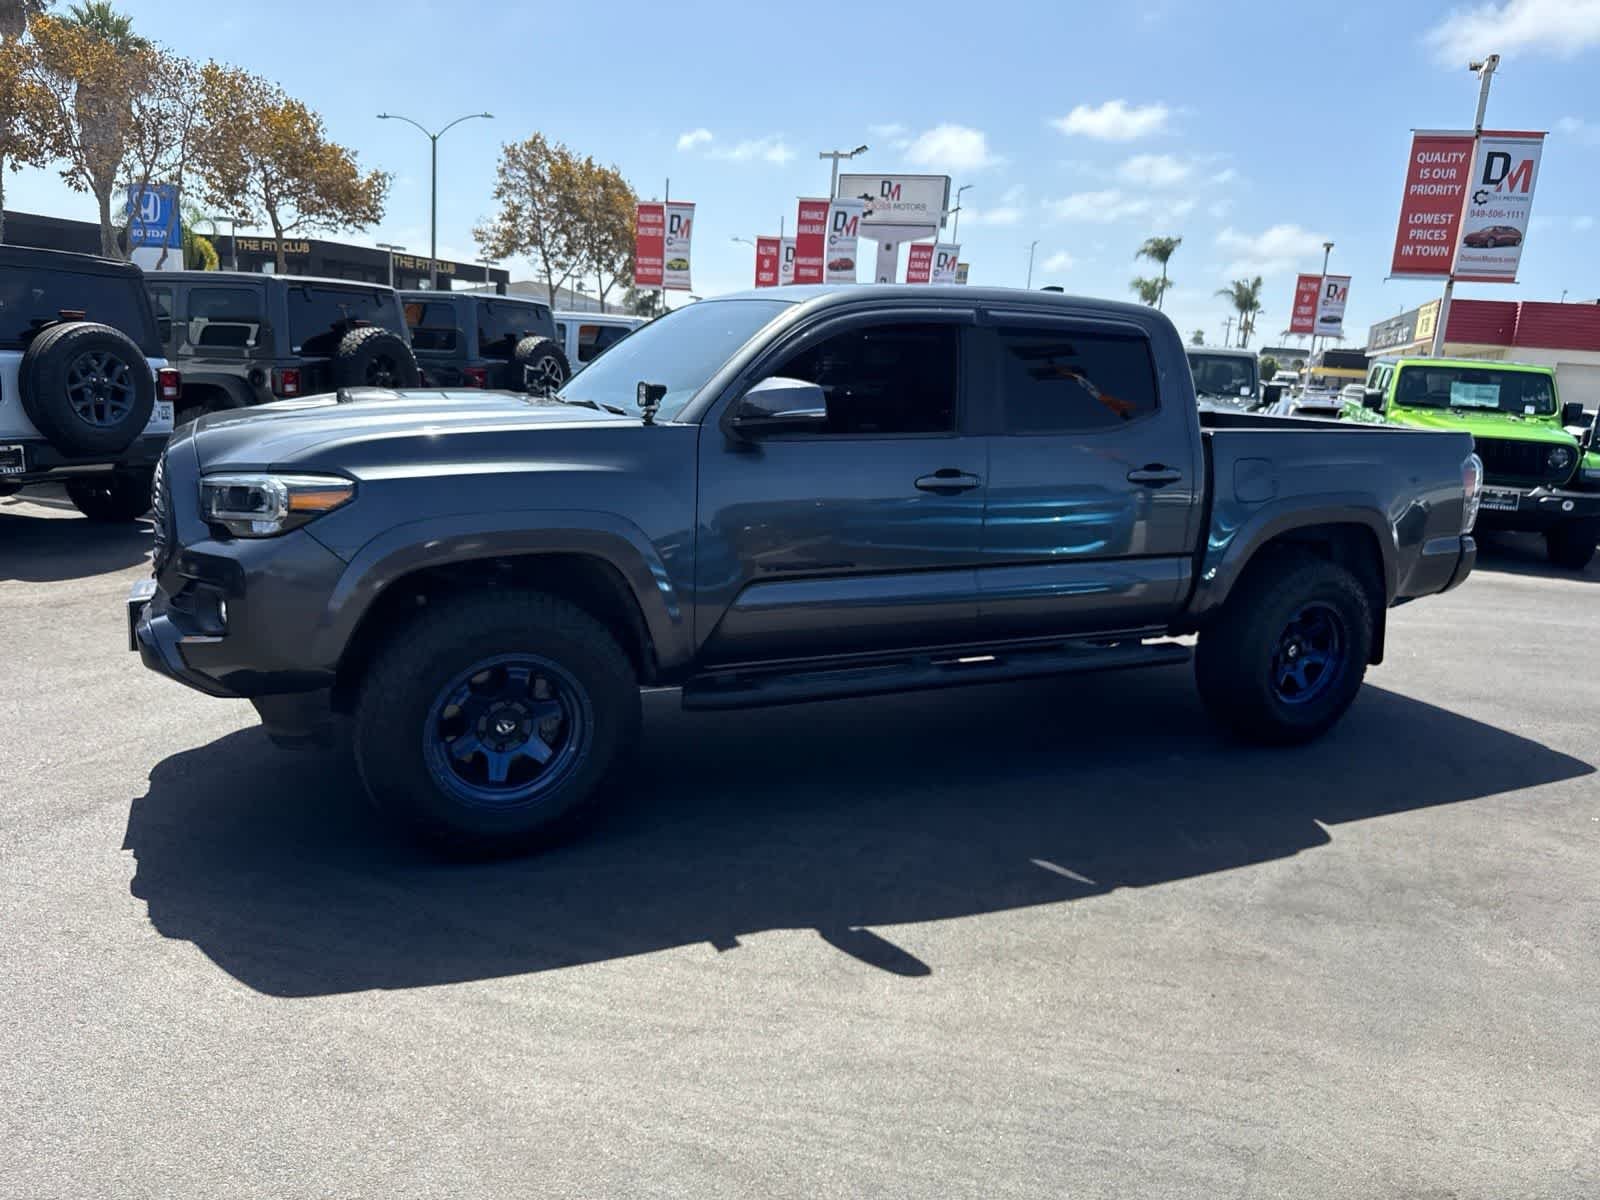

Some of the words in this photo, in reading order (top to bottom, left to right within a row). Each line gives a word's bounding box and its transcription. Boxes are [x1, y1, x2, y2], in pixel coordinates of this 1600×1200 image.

[1416, 152, 1466, 164] QUALITY
[1419, 168, 1431, 179] IS
[1432, 168, 1457, 180] OUR
[1481, 151, 1534, 193] DM
[881, 180, 902, 202] DM
[1409, 184, 1462, 196] PRIORITY
[833, 210, 859, 237] DM
[1408, 213, 1455, 225] LOWEST
[670, 214, 691, 239] DM
[1408, 229, 1448, 241] PRICES
[237, 239, 260, 250] THE
[282, 242, 311, 253] CLUB
[1401, 244, 1414, 255] IN
[1416, 245, 1450, 256] TOWN
